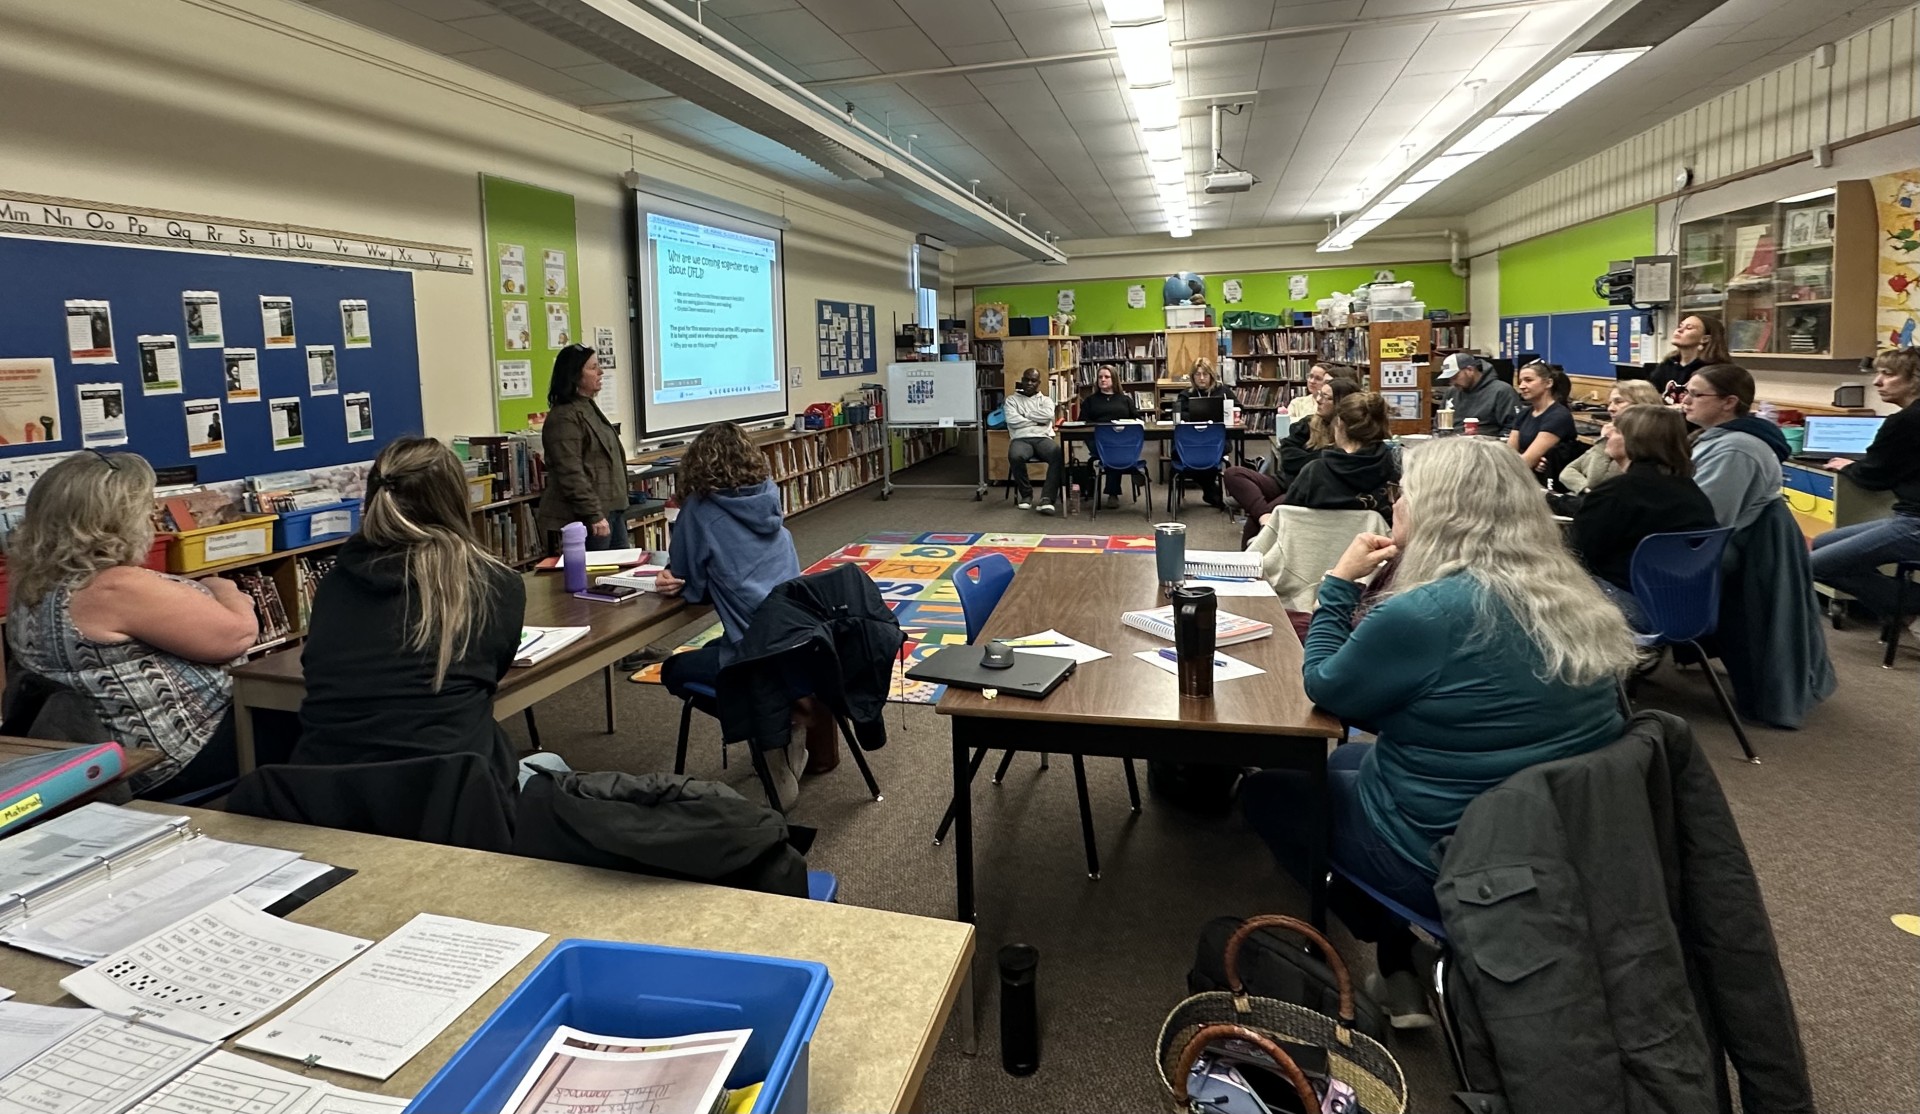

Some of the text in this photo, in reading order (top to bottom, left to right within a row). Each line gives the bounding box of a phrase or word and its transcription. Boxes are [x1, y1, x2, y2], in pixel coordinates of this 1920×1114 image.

[0, 203, 469, 268] Mm Nn Oo Pp Qq Rr Ss Tt Uu Vv Ww Xx Yy Zz
[668, 249, 680, 263] Why
[682, 254, 691, 264] are
[692, 256, 700, 265] we
[702, 256, 720, 269] coming
[669, 264, 686, 275] about
[901, 546, 956, 560] Q
[878, 563, 942, 575] R
[556, 1088, 611, 1106] hammock
